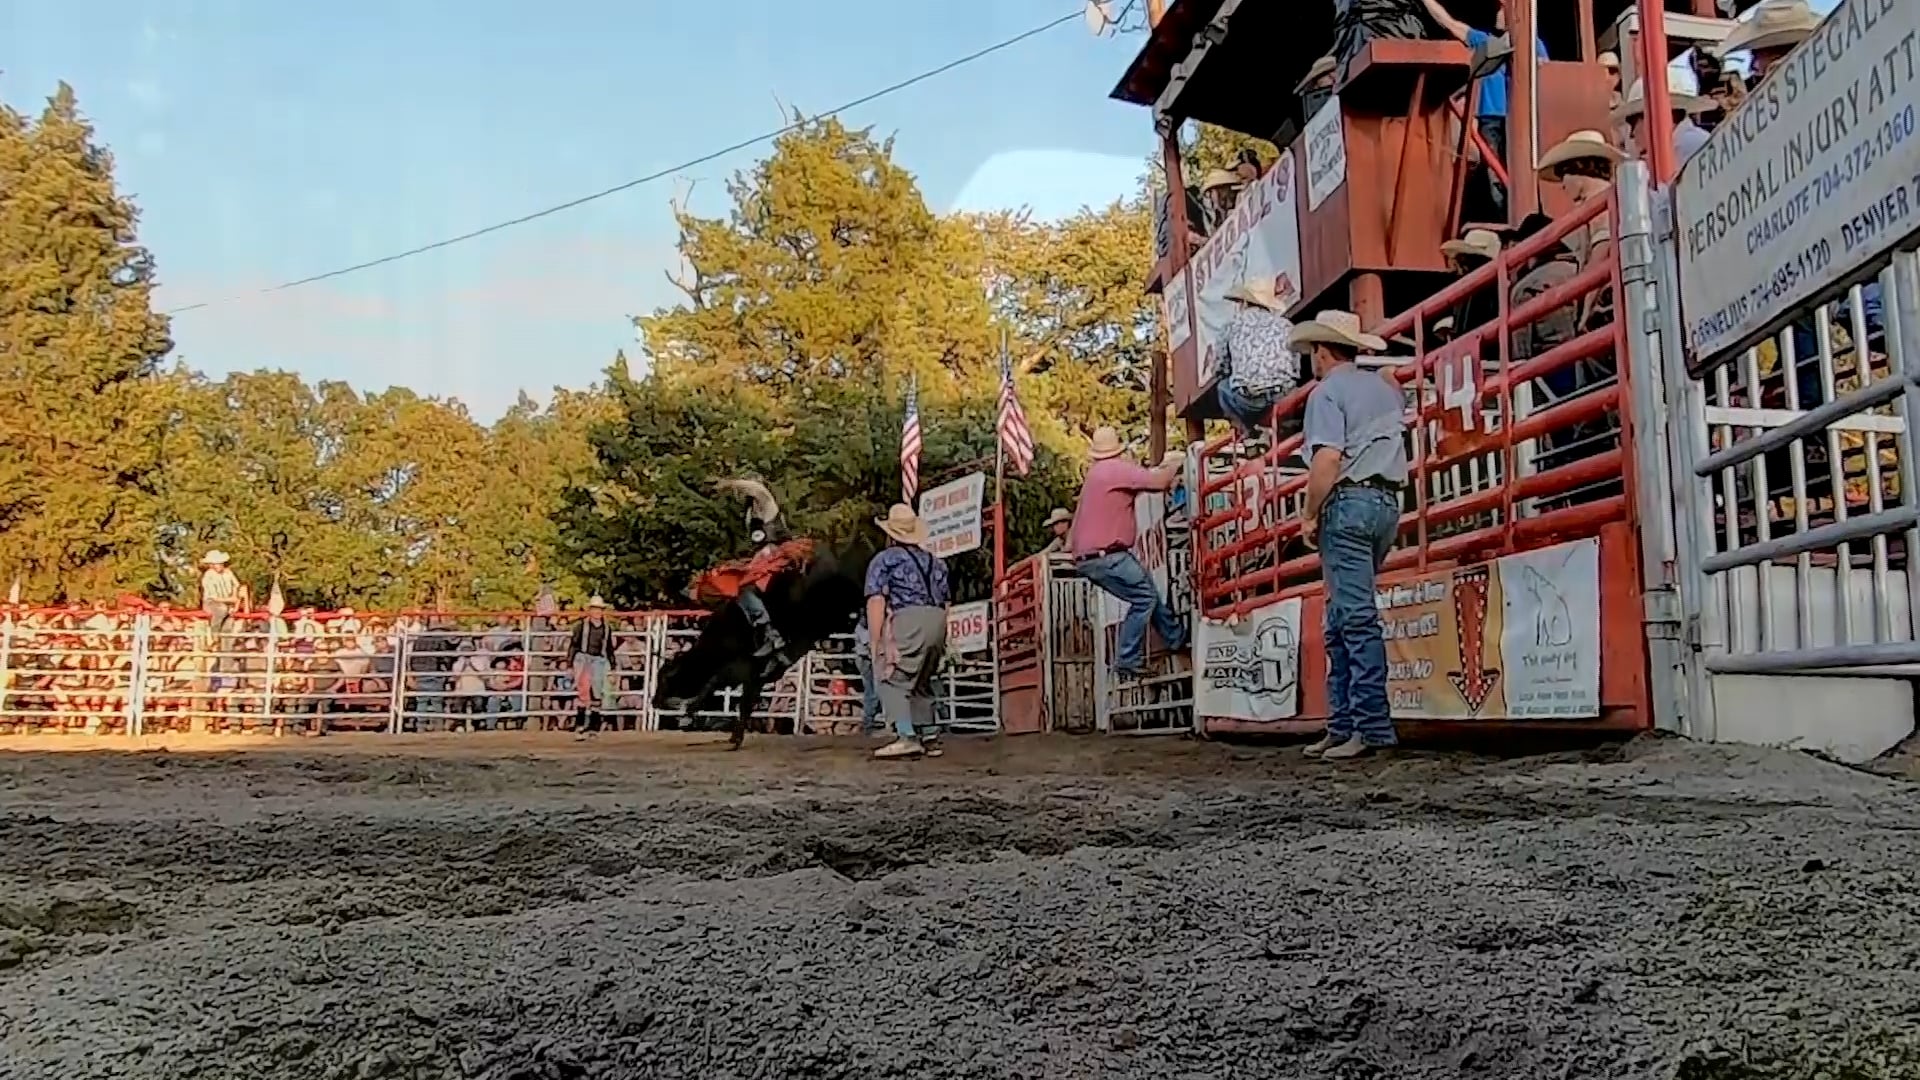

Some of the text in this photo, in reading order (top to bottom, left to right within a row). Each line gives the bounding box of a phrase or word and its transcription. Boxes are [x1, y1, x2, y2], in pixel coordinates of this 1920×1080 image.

[1687, 28, 1920, 263] PERSONAL INJURY ATT
[1697, 81, 1780, 189] FRANCES
[1746, 103, 1915, 255] CHARLOTE 704-372-1360
[1841, 185, 1910, 252] DENVER
[1443, 355, 1477, 432] 4
[1242, 474, 1261, 533] 3
